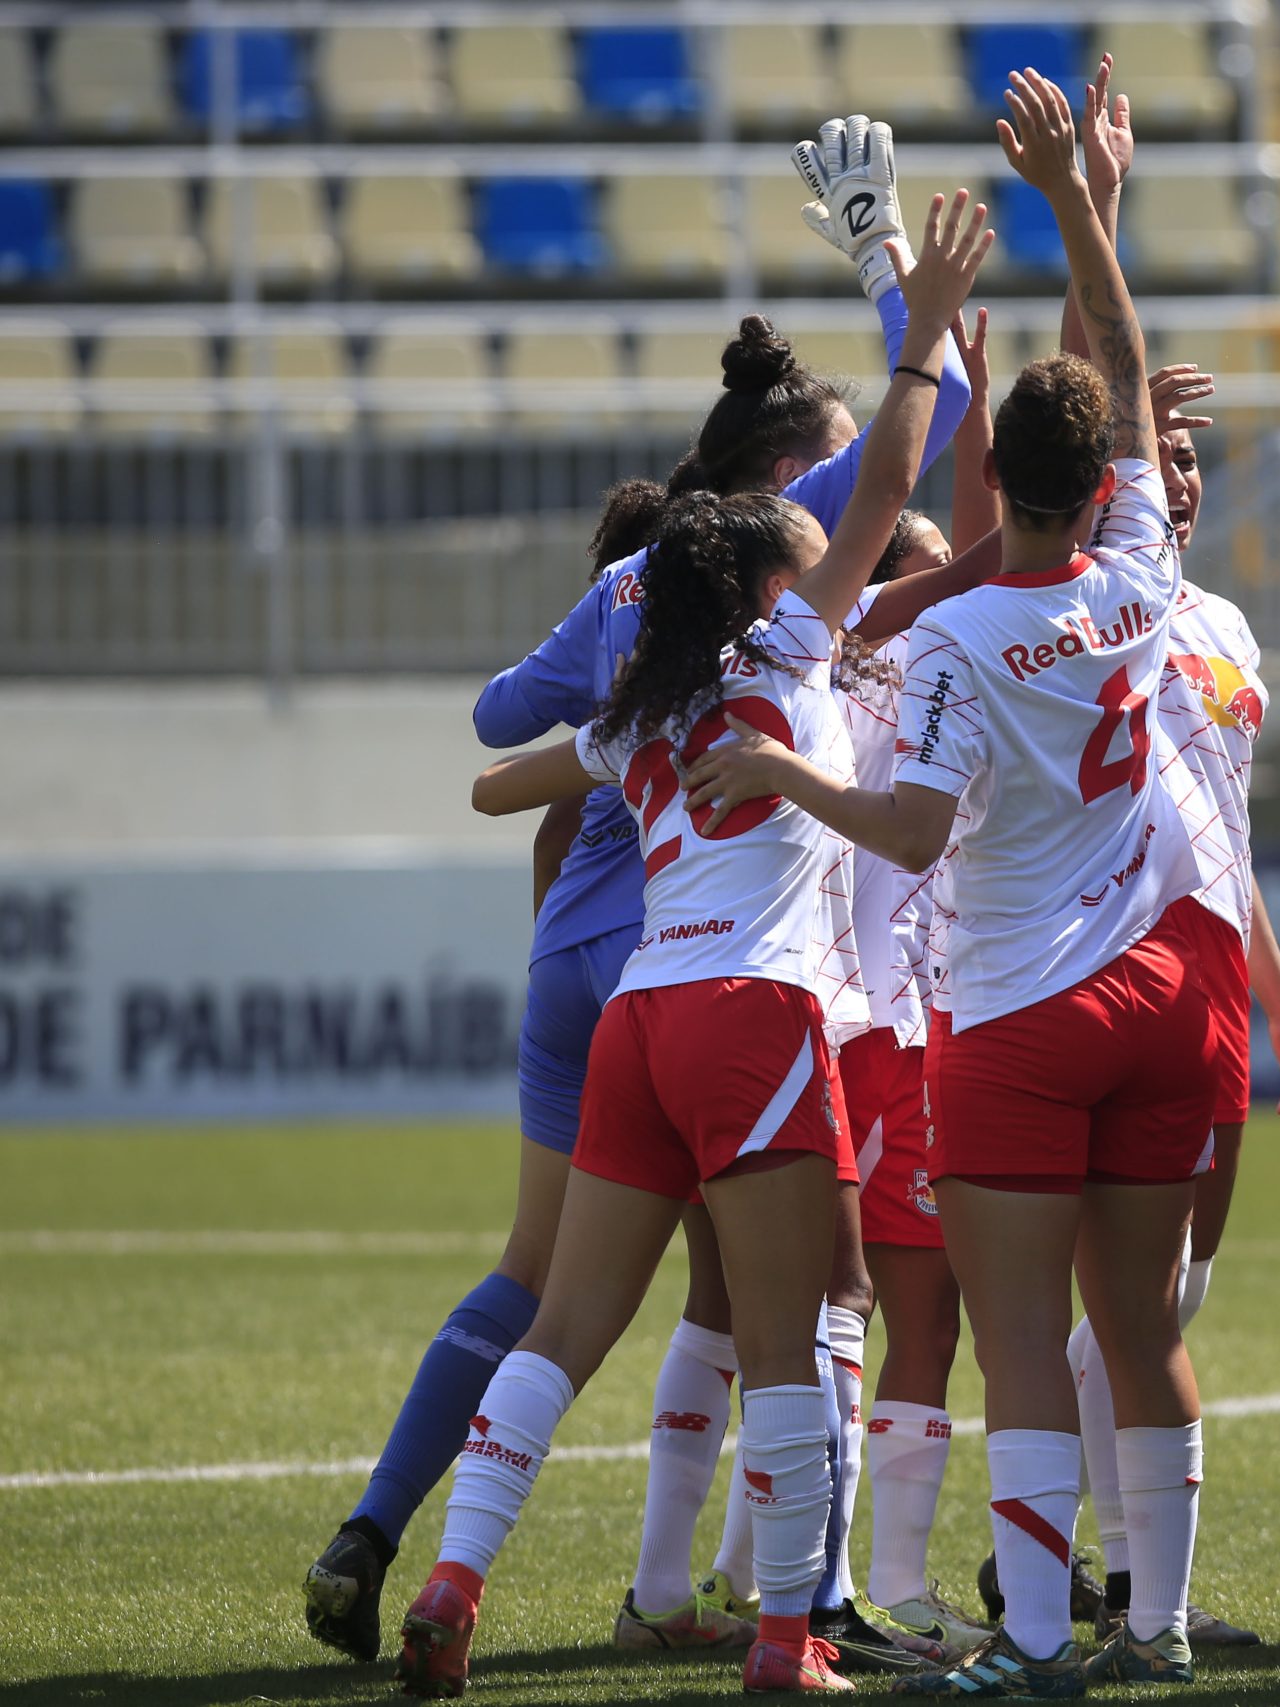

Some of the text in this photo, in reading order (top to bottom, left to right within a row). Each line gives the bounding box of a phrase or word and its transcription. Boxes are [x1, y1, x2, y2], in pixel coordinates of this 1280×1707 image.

[1078, 663, 1149, 807] 4
[659, 919, 735, 944] YANMAR
[116, 952, 520, 1084] PARNAÍB
